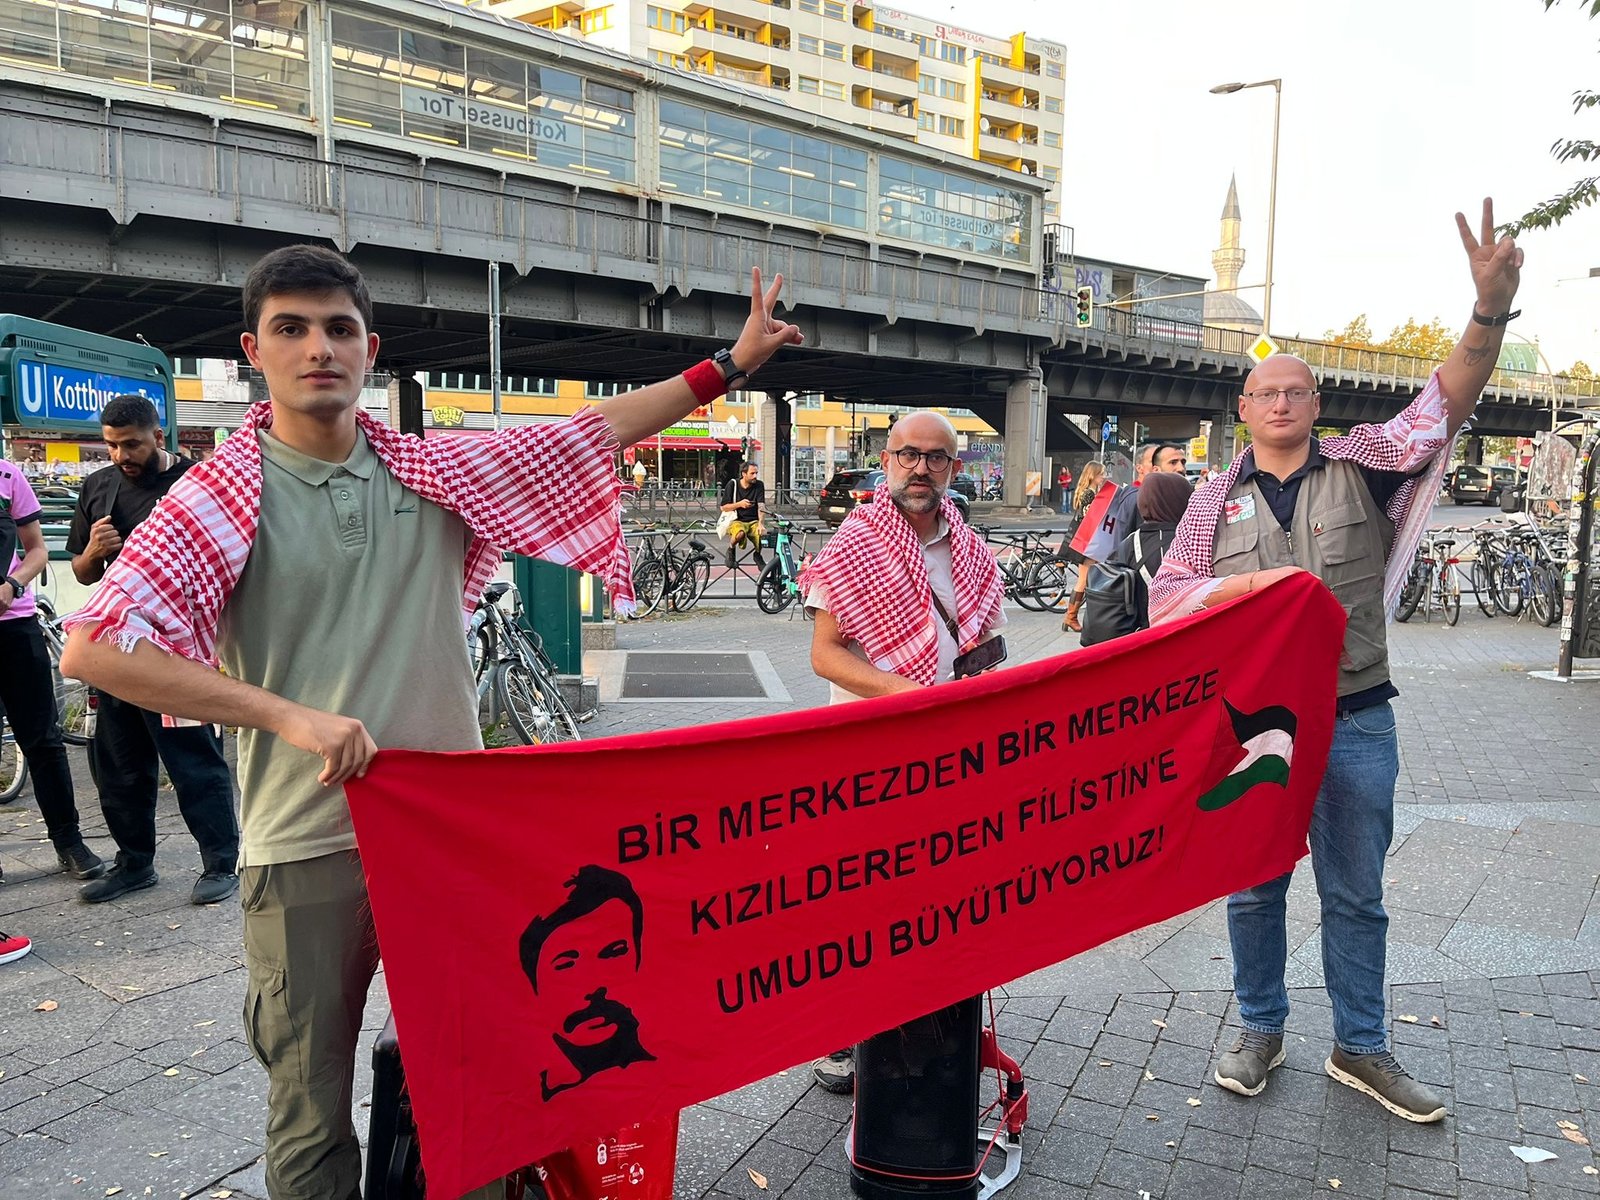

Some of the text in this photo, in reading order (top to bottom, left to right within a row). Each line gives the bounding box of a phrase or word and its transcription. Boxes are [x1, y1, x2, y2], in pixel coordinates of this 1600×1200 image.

[21, 363, 42, 413] U
[53, 375, 129, 412] Kottbu
[617, 668, 1220, 864] BİR MERKEZDEN BİR MERKEZE
[690, 748, 1179, 936] KIZILDERE'DEN FİLİSTİN'E
[716, 824, 1165, 1014] UMUDU BÜYÜTÜYORUZ!
